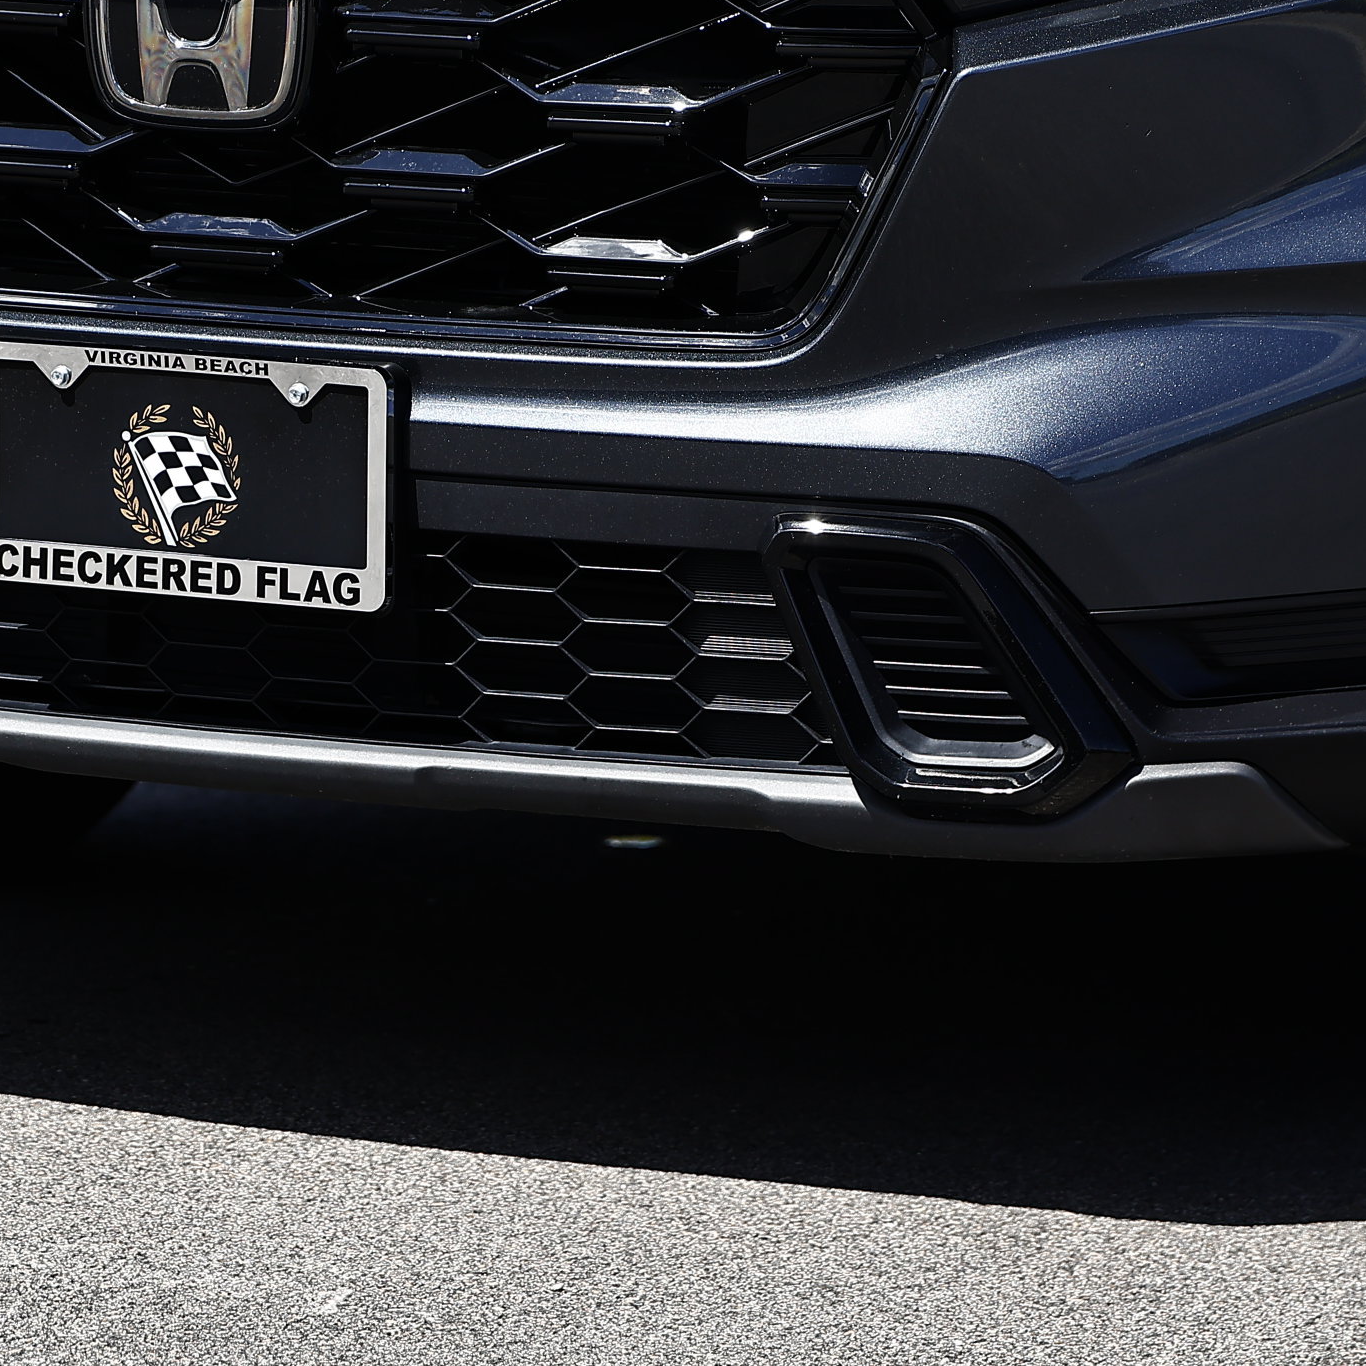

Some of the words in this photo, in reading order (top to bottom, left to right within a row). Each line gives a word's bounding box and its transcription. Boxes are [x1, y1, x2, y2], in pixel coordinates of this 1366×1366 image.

[84, 349, 187, 370] VIRGINIA
[194, 357, 269, 377] BEACH
[255, 565, 361, 607] FLAG
